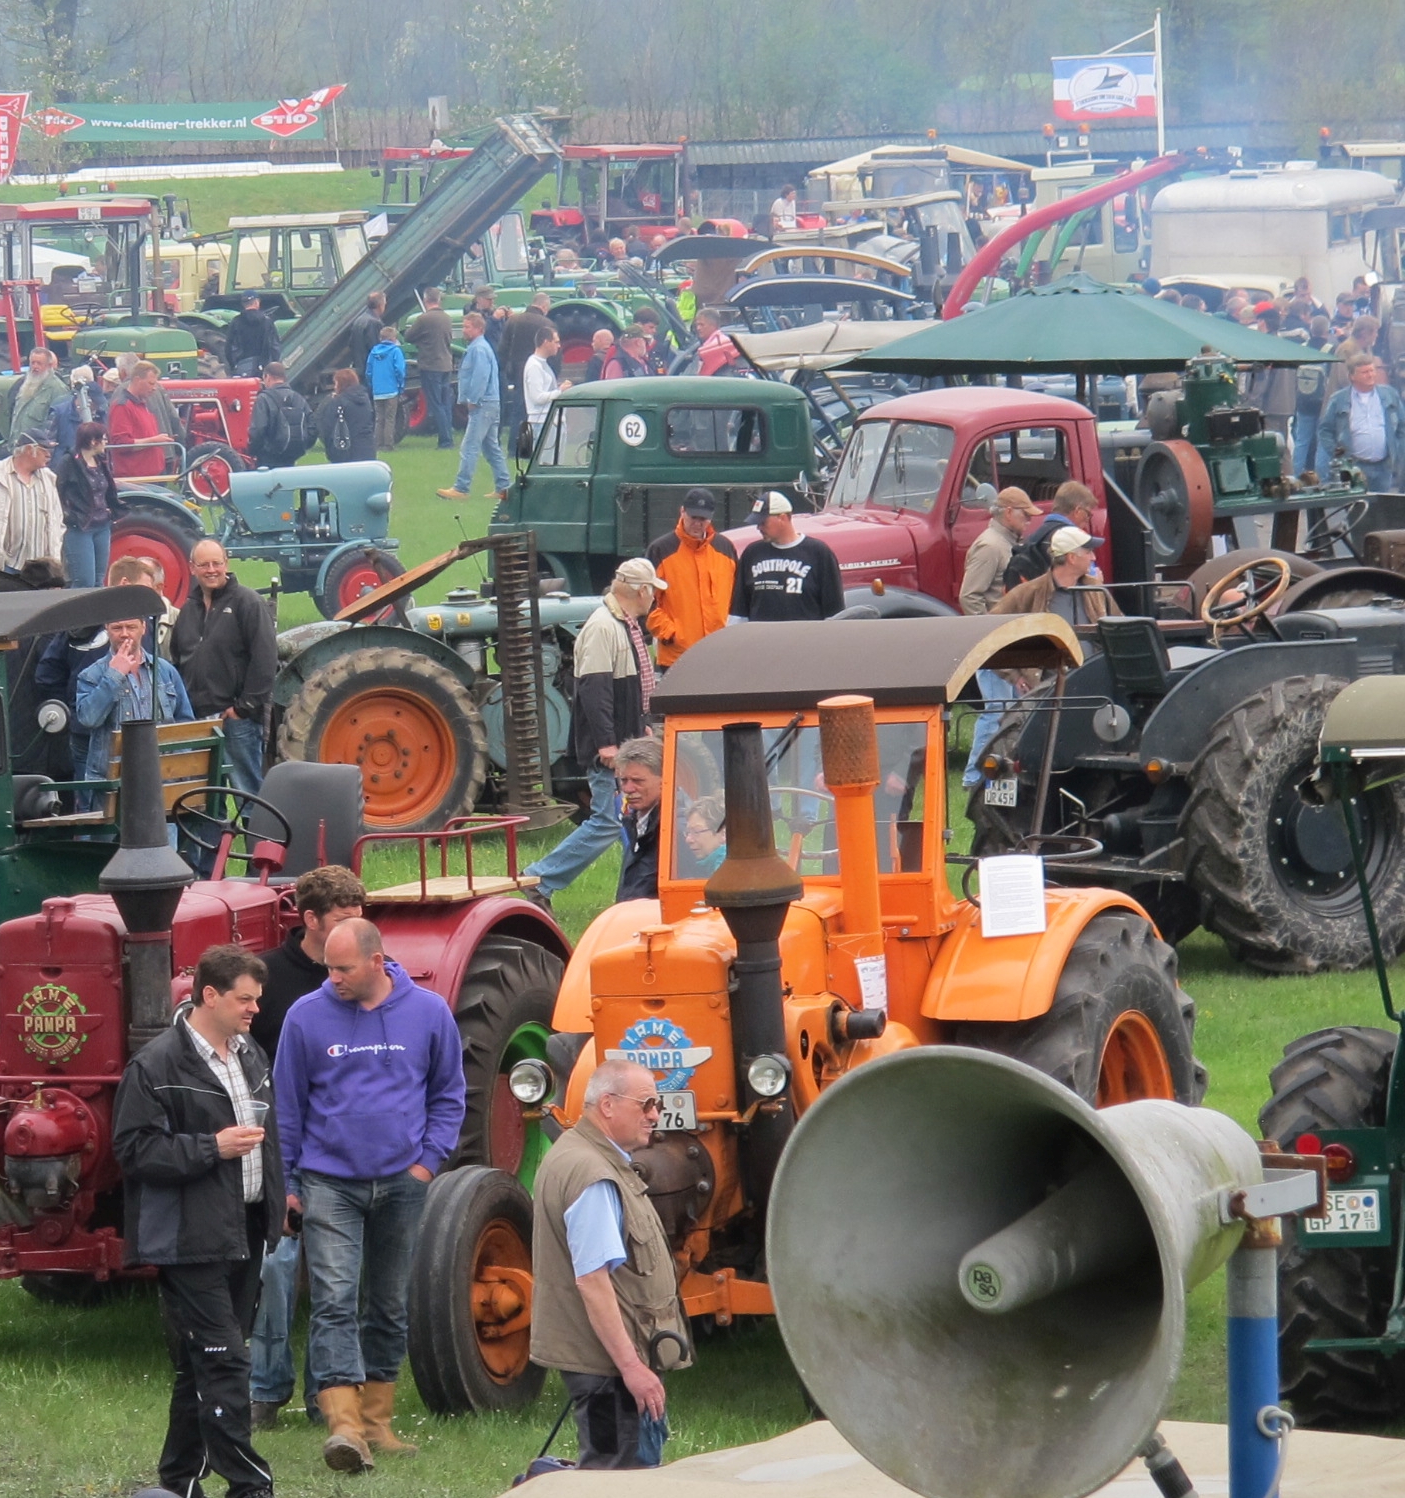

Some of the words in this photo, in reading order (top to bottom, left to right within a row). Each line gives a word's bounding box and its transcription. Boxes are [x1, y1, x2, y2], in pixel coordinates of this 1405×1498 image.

[90, 117, 247, 130] www.oldtimer-trekker.nl
[260, 113, 308, 126] STIO
[625, 421, 642, 438] 62
[751, 558, 812, 578] SOUTHPOLE
[786, 577, 803, 594] 21
[24, 1016, 76, 1033] PAMPA
[327, 1042, 406, 1058] Champion
[663, 1112, 685, 1128] 76
[1339, 1213, 1360, 1230] 17
